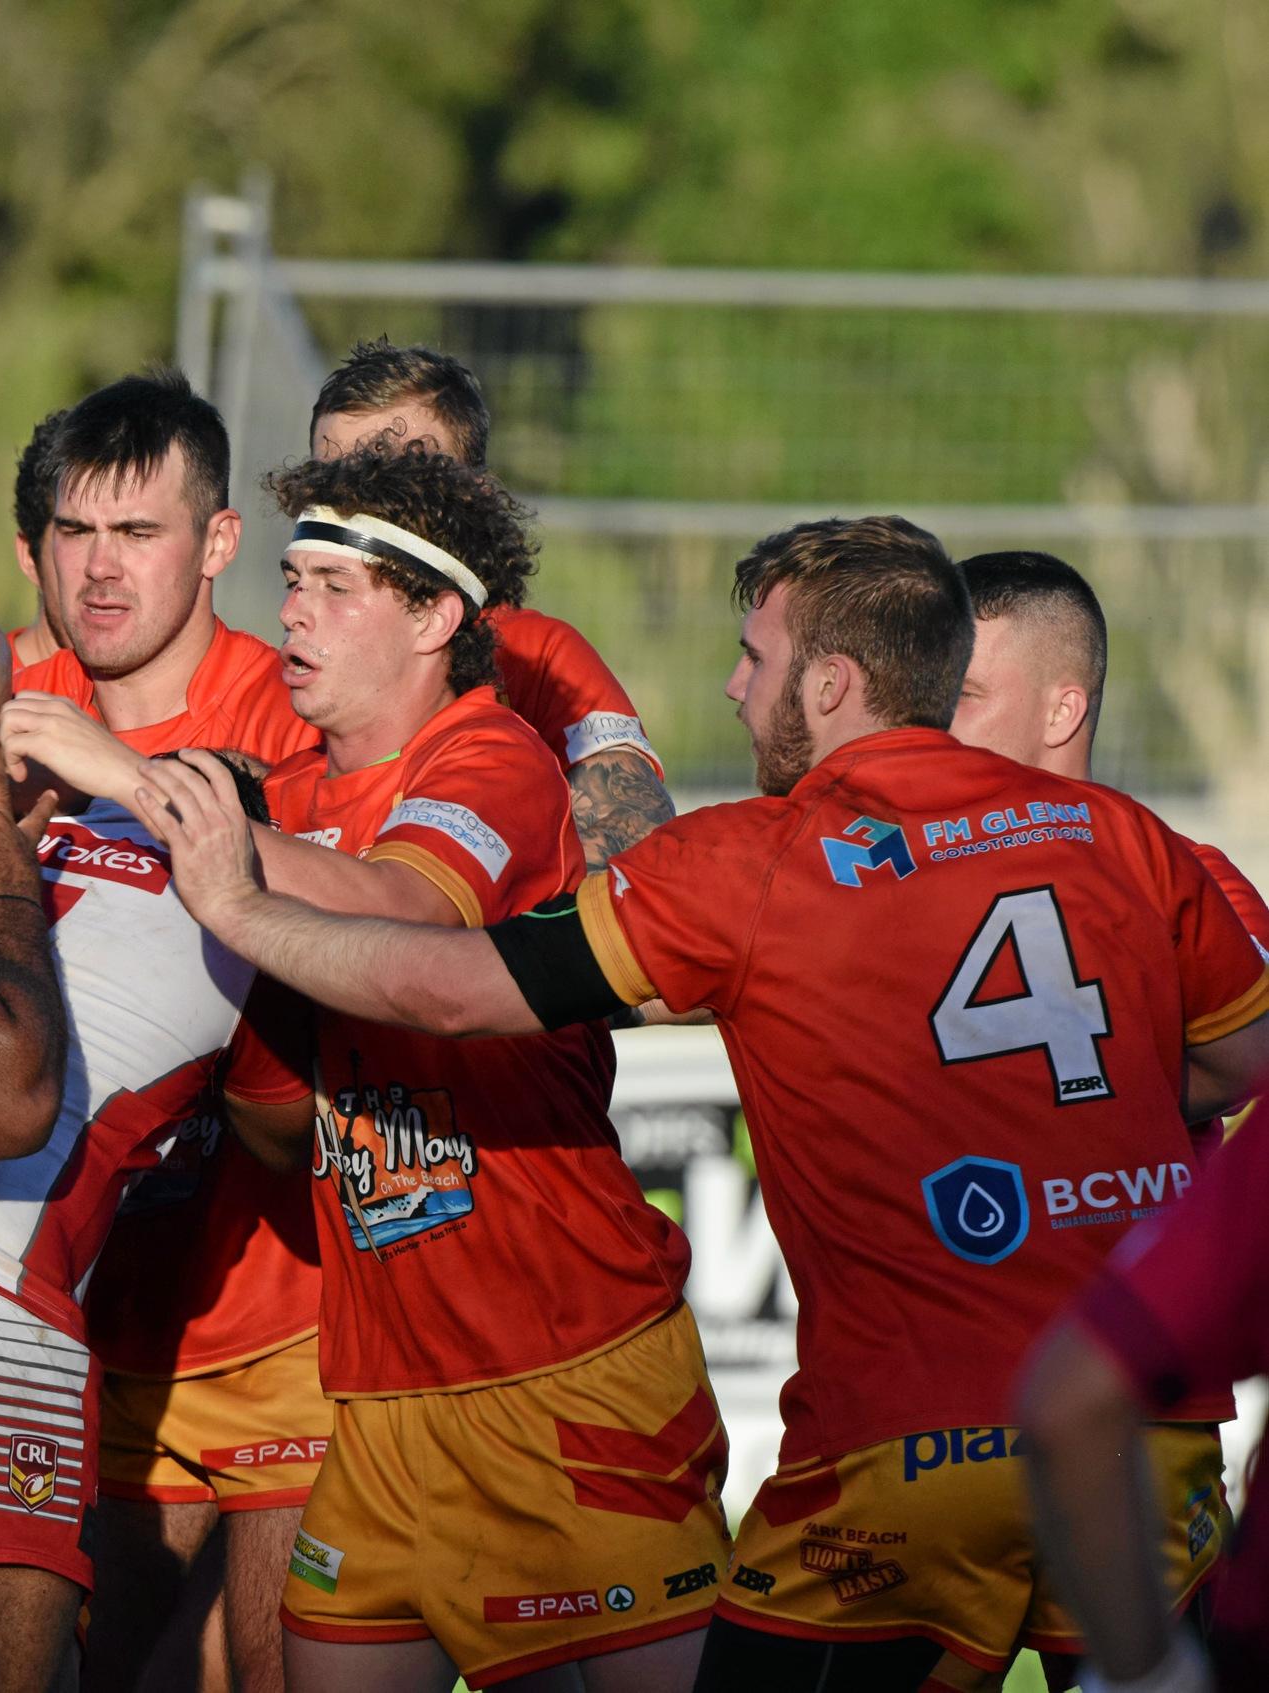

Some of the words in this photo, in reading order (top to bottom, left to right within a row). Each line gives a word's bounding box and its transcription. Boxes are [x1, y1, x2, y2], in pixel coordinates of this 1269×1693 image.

[399, 808, 482, 850] manager
[420, 799, 506, 858] mortgage
[922, 816, 973, 847] FM
[980, 800, 1092, 835] GLENN
[930, 826, 1094, 862] CONSTRUCTIONS
[927, 883, 1116, 1107] 4
[1060, 1075, 1105, 1095] ZBR
[381, 1181, 393, 1194] On
[391, 1174, 418, 1189] The
[420, 1170, 460, 1186] Beach
[1051, 1210, 1128, 1230] BANANACOAST
[15, 1441, 54, 1466] CRL
[846, 1528, 908, 1545] BEACH
[663, 1562, 719, 1600] ZBR
[732, 1563, 777, 1597] ZBR
[517, 1592, 599, 1618] SPAR
